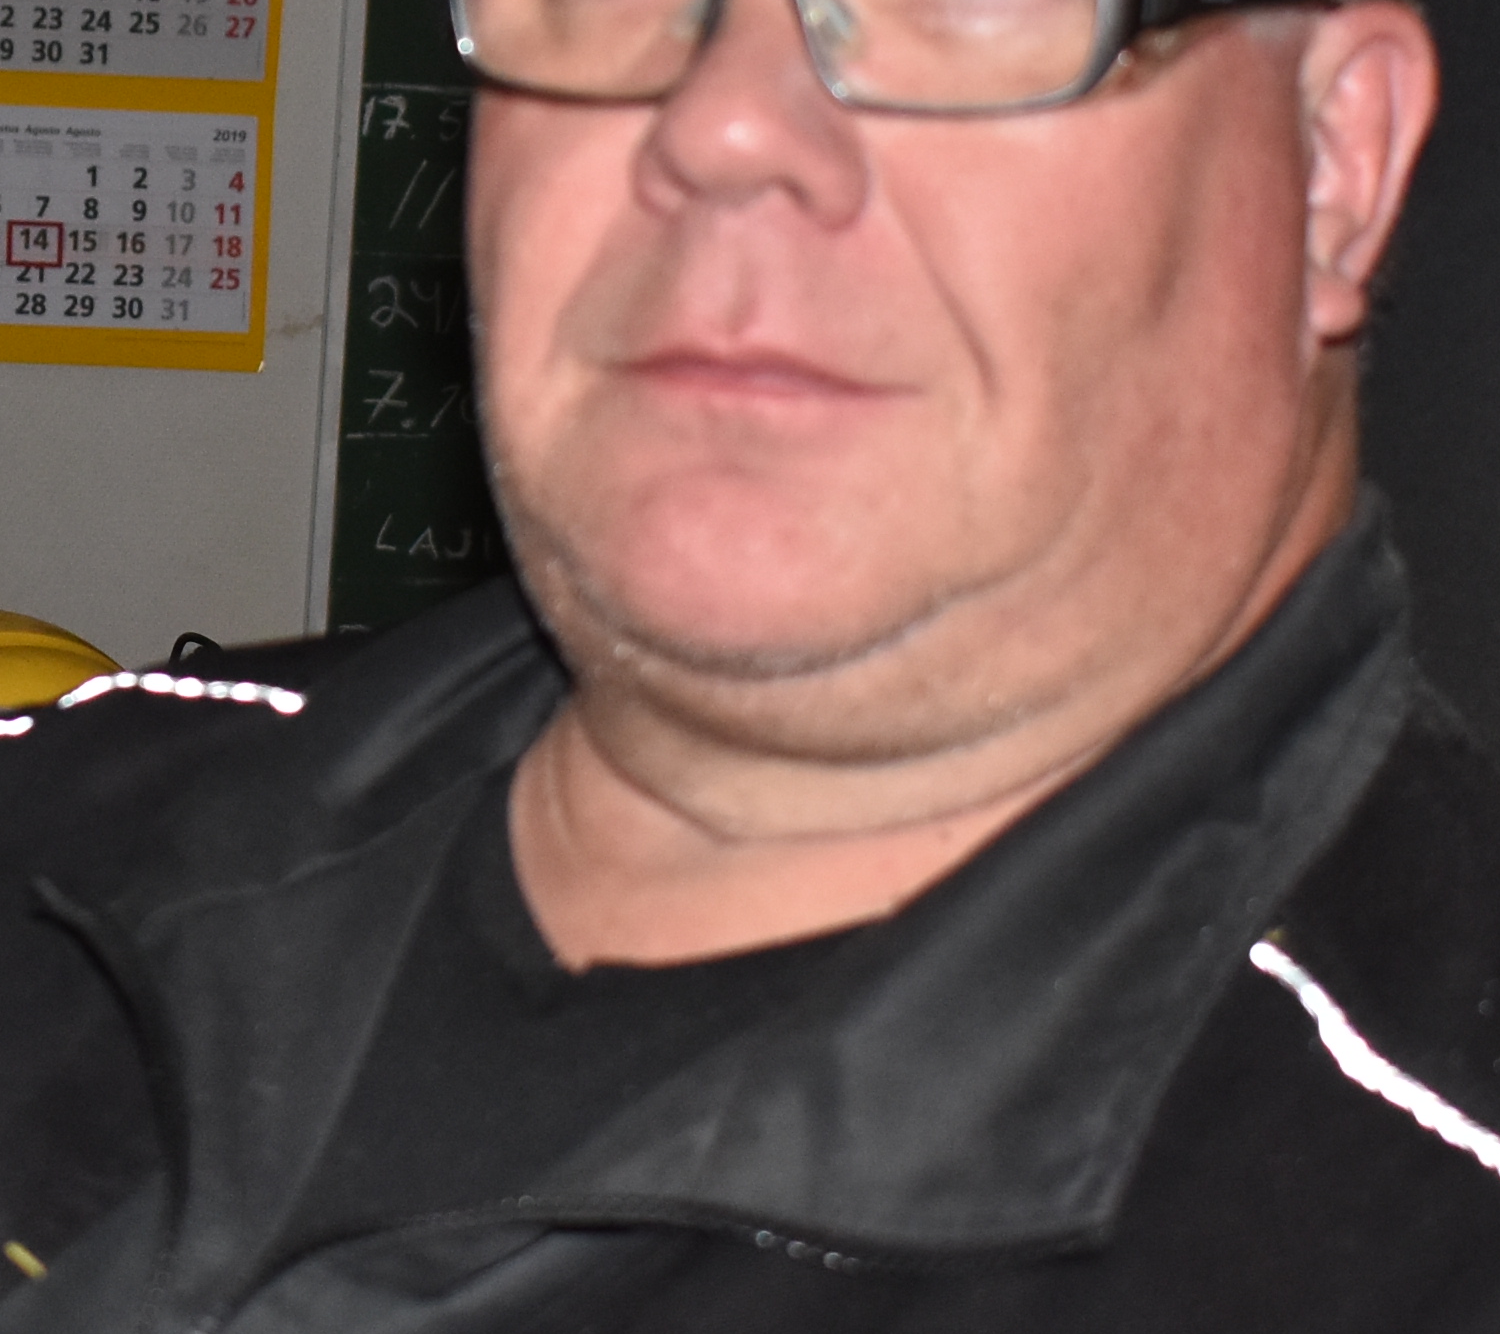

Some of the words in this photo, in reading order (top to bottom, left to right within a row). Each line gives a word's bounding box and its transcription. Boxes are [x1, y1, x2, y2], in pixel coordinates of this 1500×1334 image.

[33, 7, 63, 30] 23
[81, 9, 112, 32] 24
[129, 11, 159, 35] 25
[177, 13, 207, 37] 26
[225, 16, 257, 39] 27
[32, 40, 62, 63] 30
[80, 42, 108, 65] 31
[213, 129, 248, 144] 2019
[87, 165, 97, 187] 1
[133, 167, 147, 189] 2
[182, 169, 196, 192] 3
[229, 171, 245, 193] 4
[36, 196, 50, 217] 7
[83, 197, 98, 220] 8
[132, 199, 147, 222] 9
[167, 201, 196, 224] 10
[215, 203, 241, 225] 11
[20, 228, 49, 250] 14
[68, 229, 97, 253] 15
[117, 232, 146, 254] 16
[165, 233, 193, 256] 17
[213, 236, 242, 258] 18
[65, 260, 96, 285] 22
[113, 264, 144, 287] 23
[162, 266, 192, 288] 24
[210, 267, 240, 290] 25
[15, 293, 46, 316] 28
[64, 295, 95, 317] 29
[113, 296, 143, 319] 30
[161, 298, 189, 321] 31
